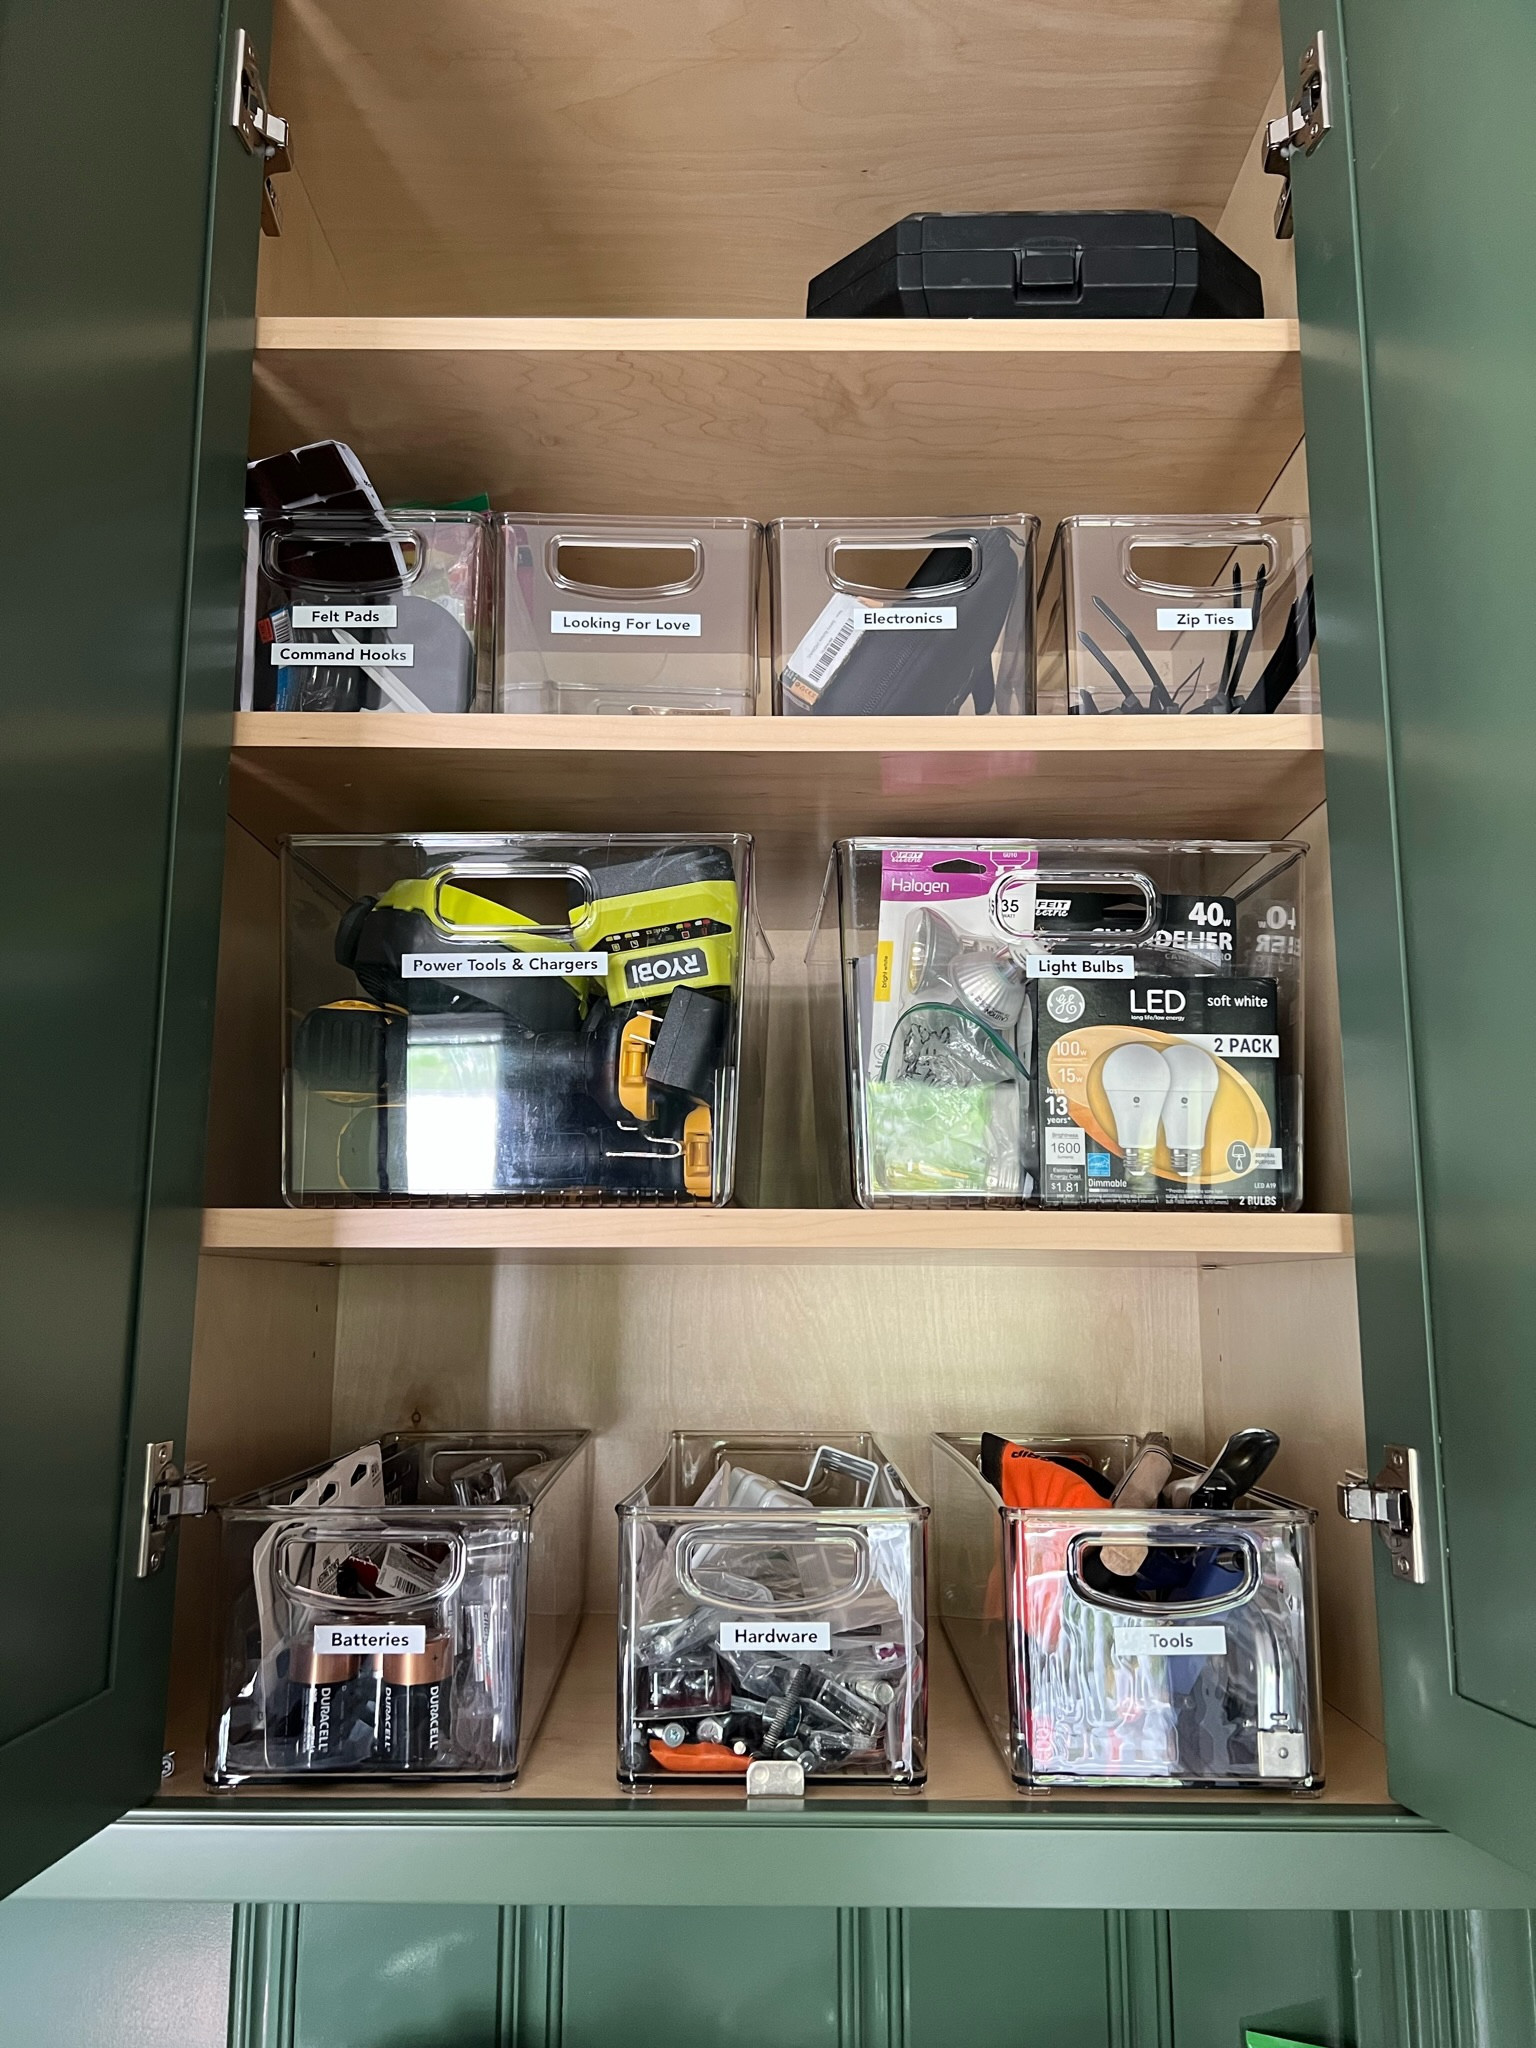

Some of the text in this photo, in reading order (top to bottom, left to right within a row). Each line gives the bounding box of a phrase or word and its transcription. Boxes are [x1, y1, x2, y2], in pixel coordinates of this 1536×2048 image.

[312, 610, 380, 623] Felt Pads
[864, 612, 943, 625] Electronics
[1177, 613, 1234, 628] Zip Ties
[563, 617, 691, 633] Looking For Love
[280, 648, 407, 661] Command Hooks
[891, 878, 950, 895] Halogen
[1001, 899, 1019, 913] 35
[413, 957, 598, 973] Power Tools & Chargers
[631, 954, 701, 984] RYOBI
[1039, 960, 1124, 975] Light Bulbs
[1130, 989, 1186, 1013] LED
[1207, 995, 1268, 1007] soft white
[1214, 1038, 1273, 1053] 2 PACK
[1045, 1095, 1068, 1116] 13
[1051, 1142, 1081, 1154] 1600
[1051, 1182, 1079, 1193] $1.81
[1088, 1179, 1128, 1188] Dimmable
[1239, 1196, 1245, 1206] 2
[1247, 1196, 1277, 1206] BULBS
[331, 1631, 409, 1647] Batteries
[735, 1628, 818, 1643] Hardware
[1149, 1632, 1194, 1648] Tools
[318, 1687, 332, 1751] DURACELL
[384, 1686, 392, 1749] DURACELL
[429, 1685, 440, 1750] DURACELL
